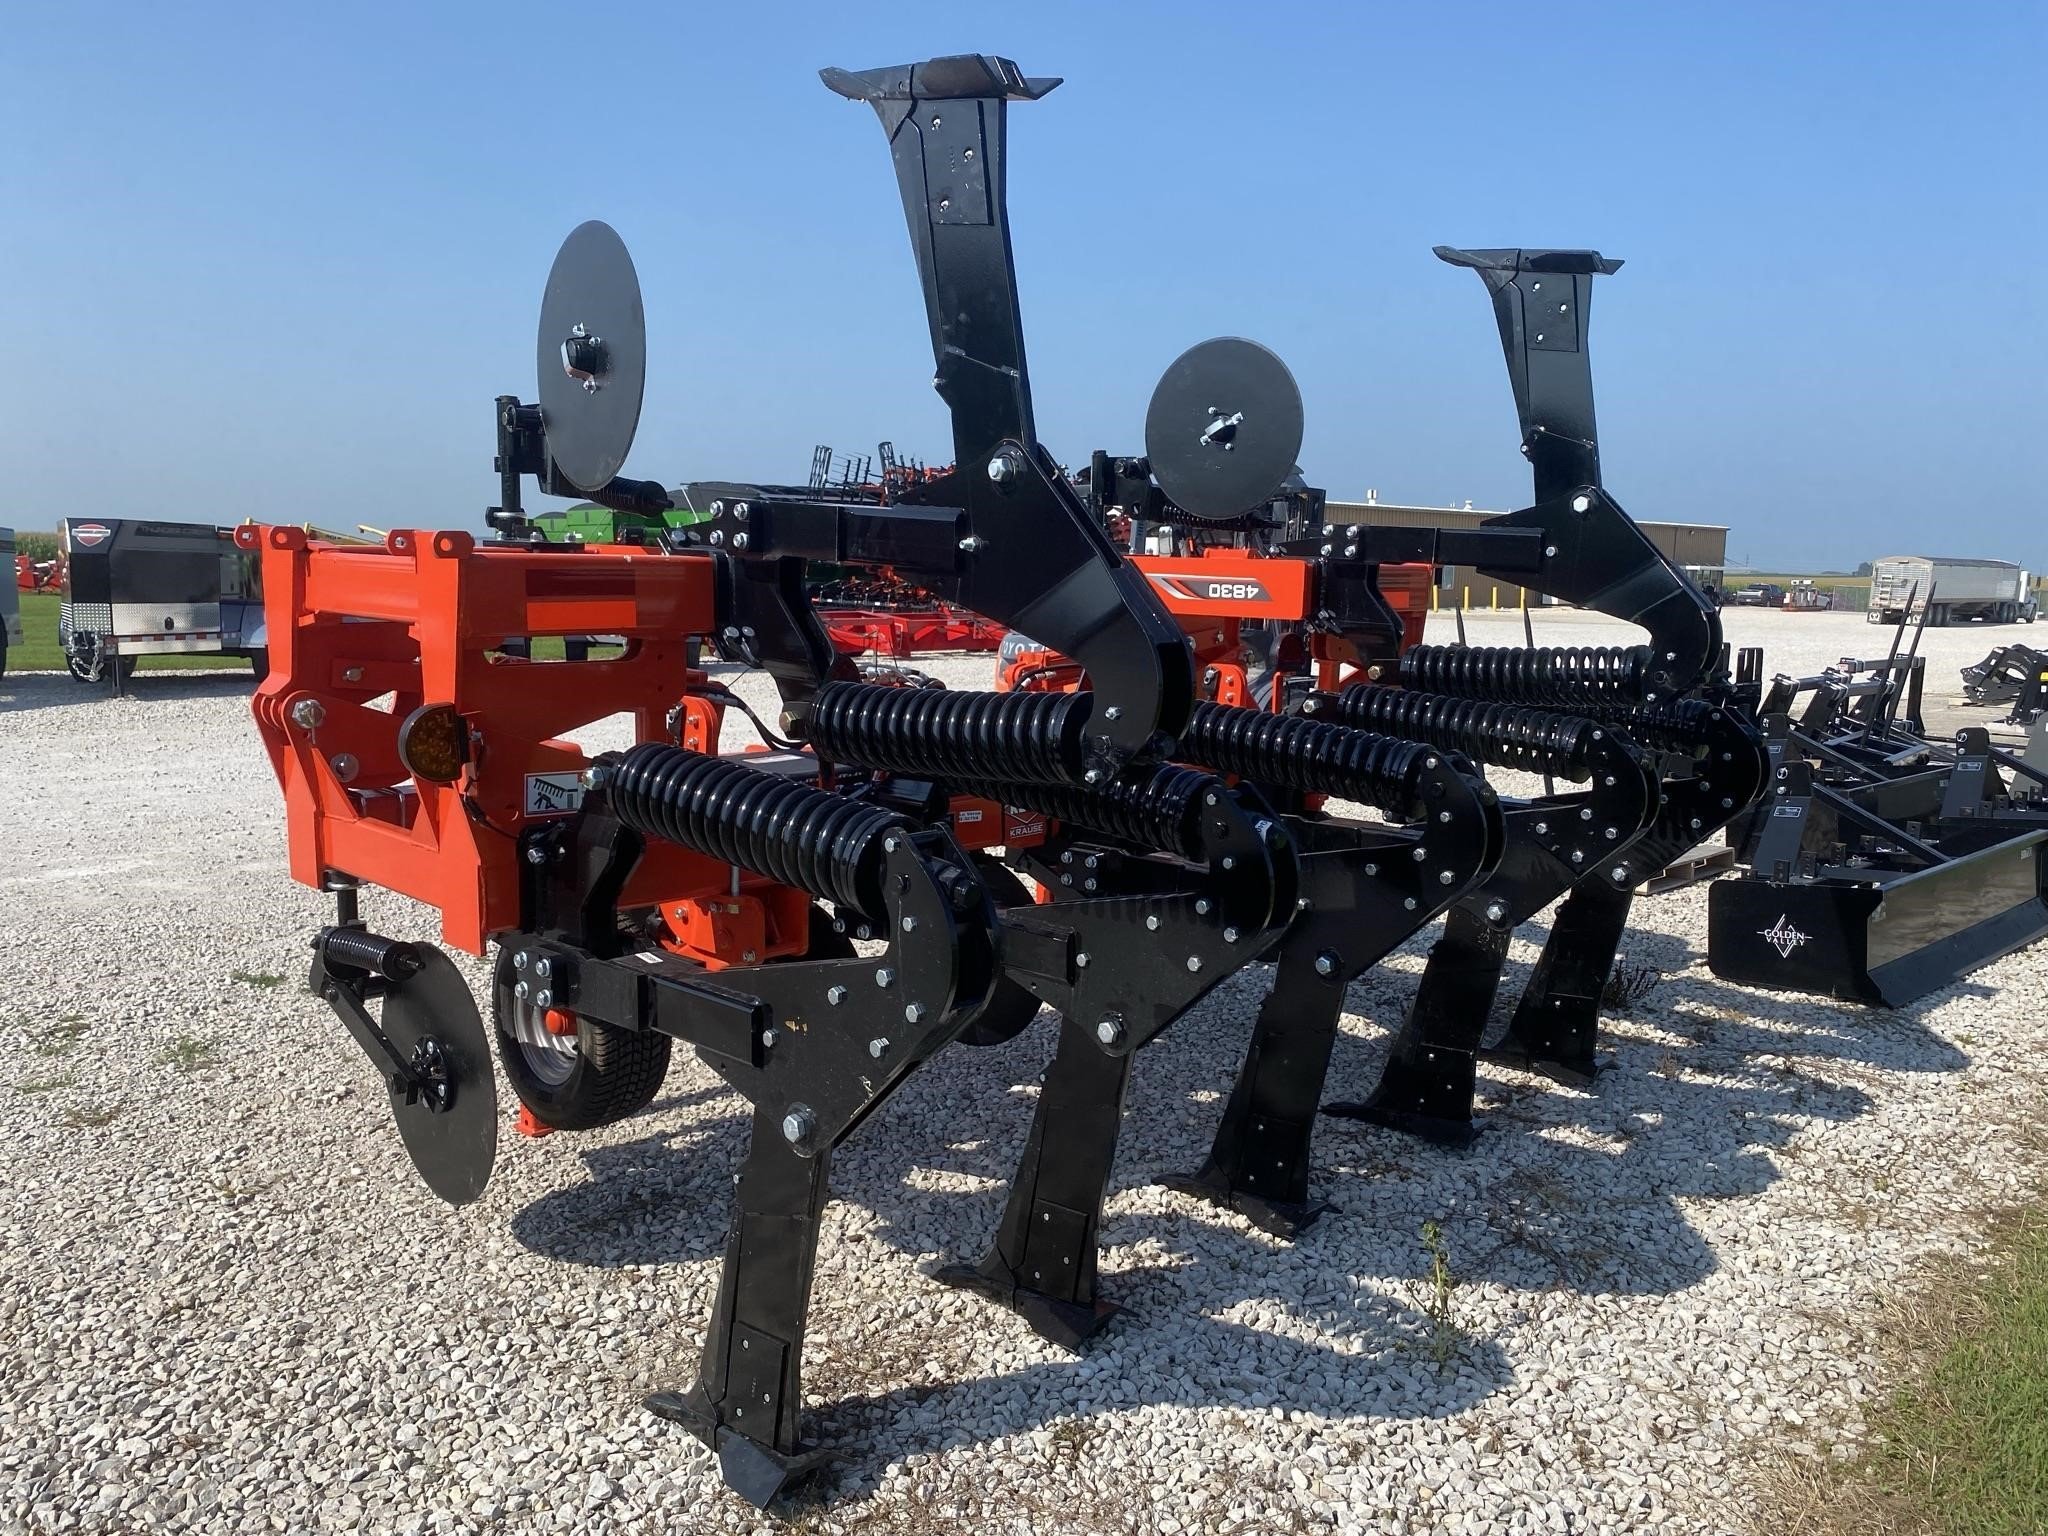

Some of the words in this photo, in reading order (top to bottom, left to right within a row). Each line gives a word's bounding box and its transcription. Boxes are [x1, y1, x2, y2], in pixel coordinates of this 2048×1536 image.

[1208, 583, 1259, 599] 4830
[1009, 824, 1043, 837] KRAUSE
[1764, 929, 1805, 940] GOLDEN
[1765, 936, 1805, 946] VALLEY
